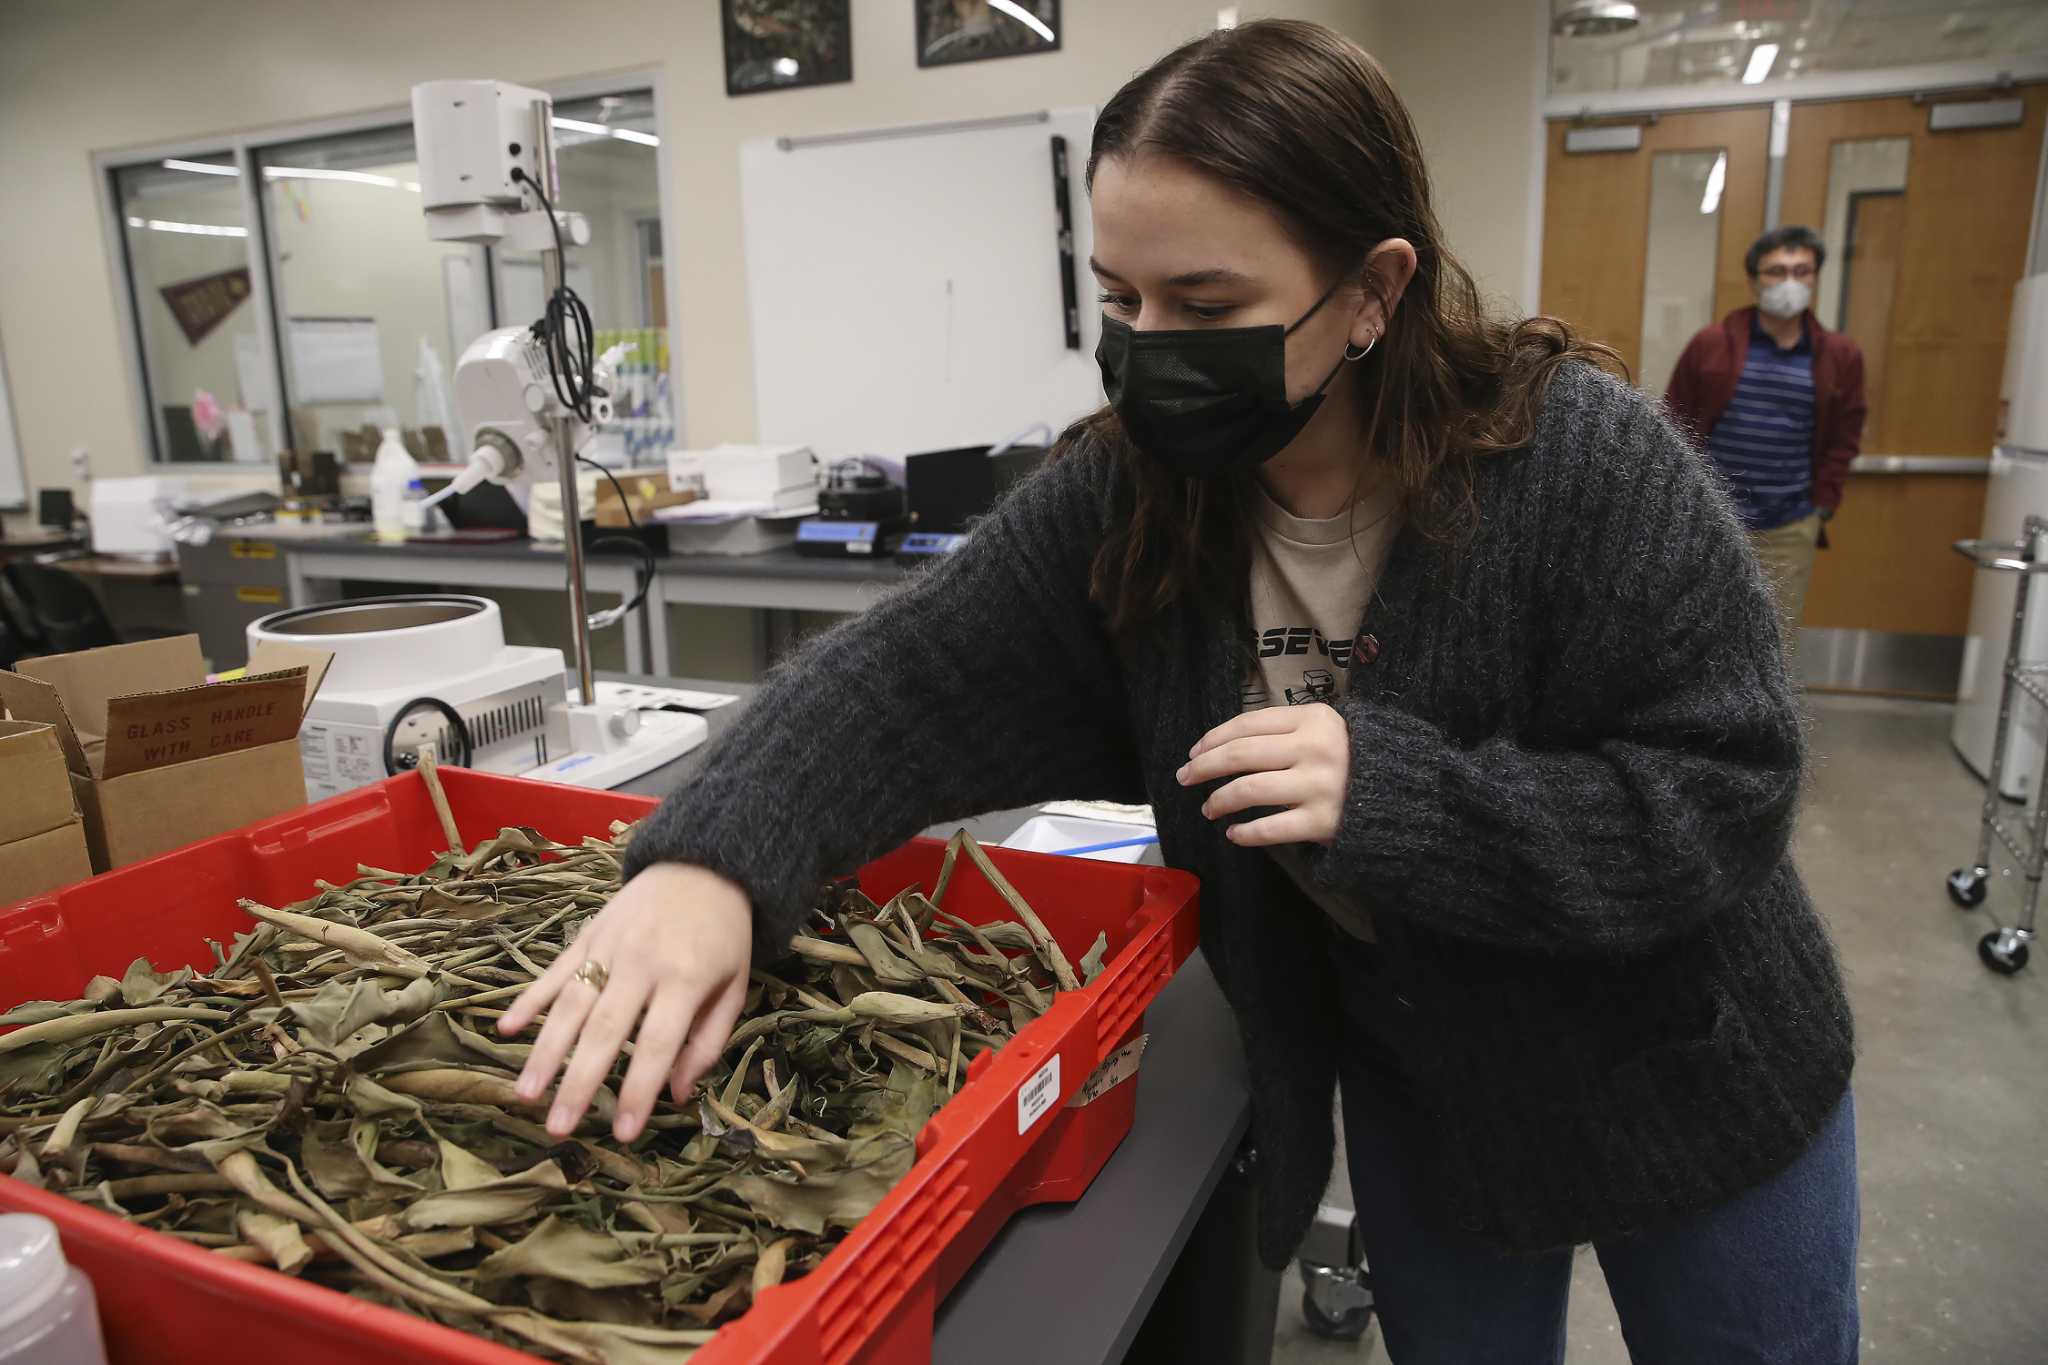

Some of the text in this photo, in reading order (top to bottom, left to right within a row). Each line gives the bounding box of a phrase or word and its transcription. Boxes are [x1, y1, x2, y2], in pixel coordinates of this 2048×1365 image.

[127, 702, 277, 740] GLASS HANDLE
[144, 728, 256, 761] WITH CARE
